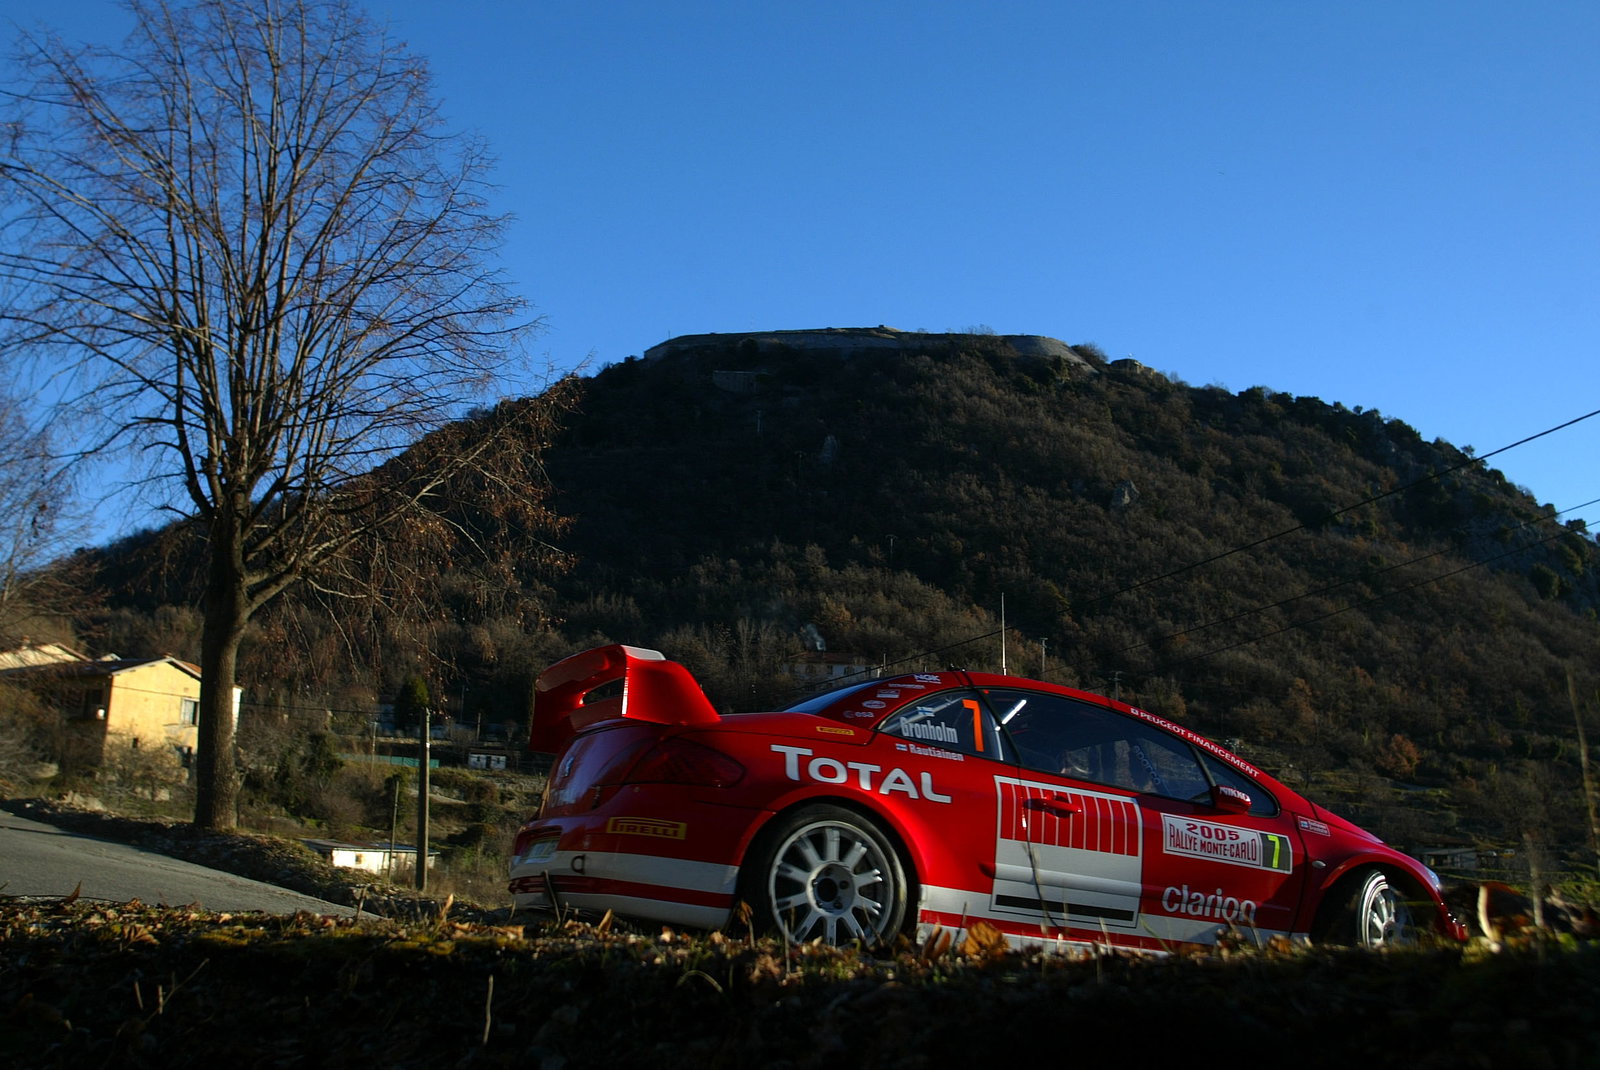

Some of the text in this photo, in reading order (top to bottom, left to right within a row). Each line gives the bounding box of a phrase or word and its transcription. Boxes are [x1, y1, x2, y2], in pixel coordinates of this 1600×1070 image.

[962, 699, 984, 752] 7
[1140, 712, 1260, 778] PEUGEOT FINANCEMENT
[611, 819, 679, 838] PIRELLI
[1169, 823, 1257, 862] RALLYE MONTE-CARLO
[1185, 822, 1240, 841] 2005
[1267, 834, 1281, 869] 7
